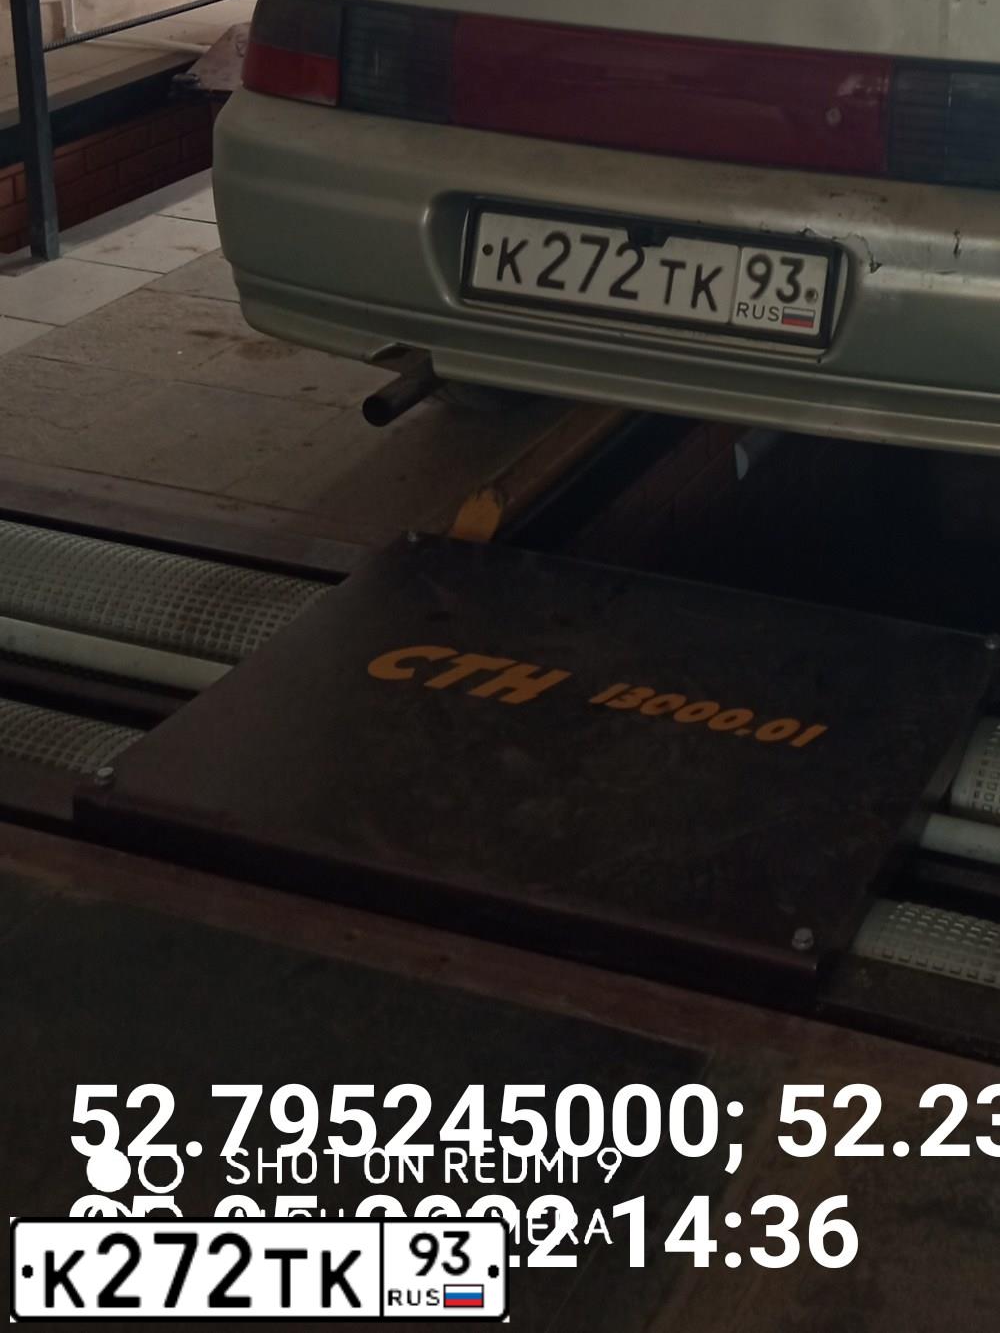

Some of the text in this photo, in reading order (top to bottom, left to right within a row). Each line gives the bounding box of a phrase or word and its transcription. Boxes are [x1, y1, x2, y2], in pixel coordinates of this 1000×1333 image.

[745, 252, 804, 304] 93
[735, 302, 781, 323] RUS
[587, 682, 828, 748] 13000.01
